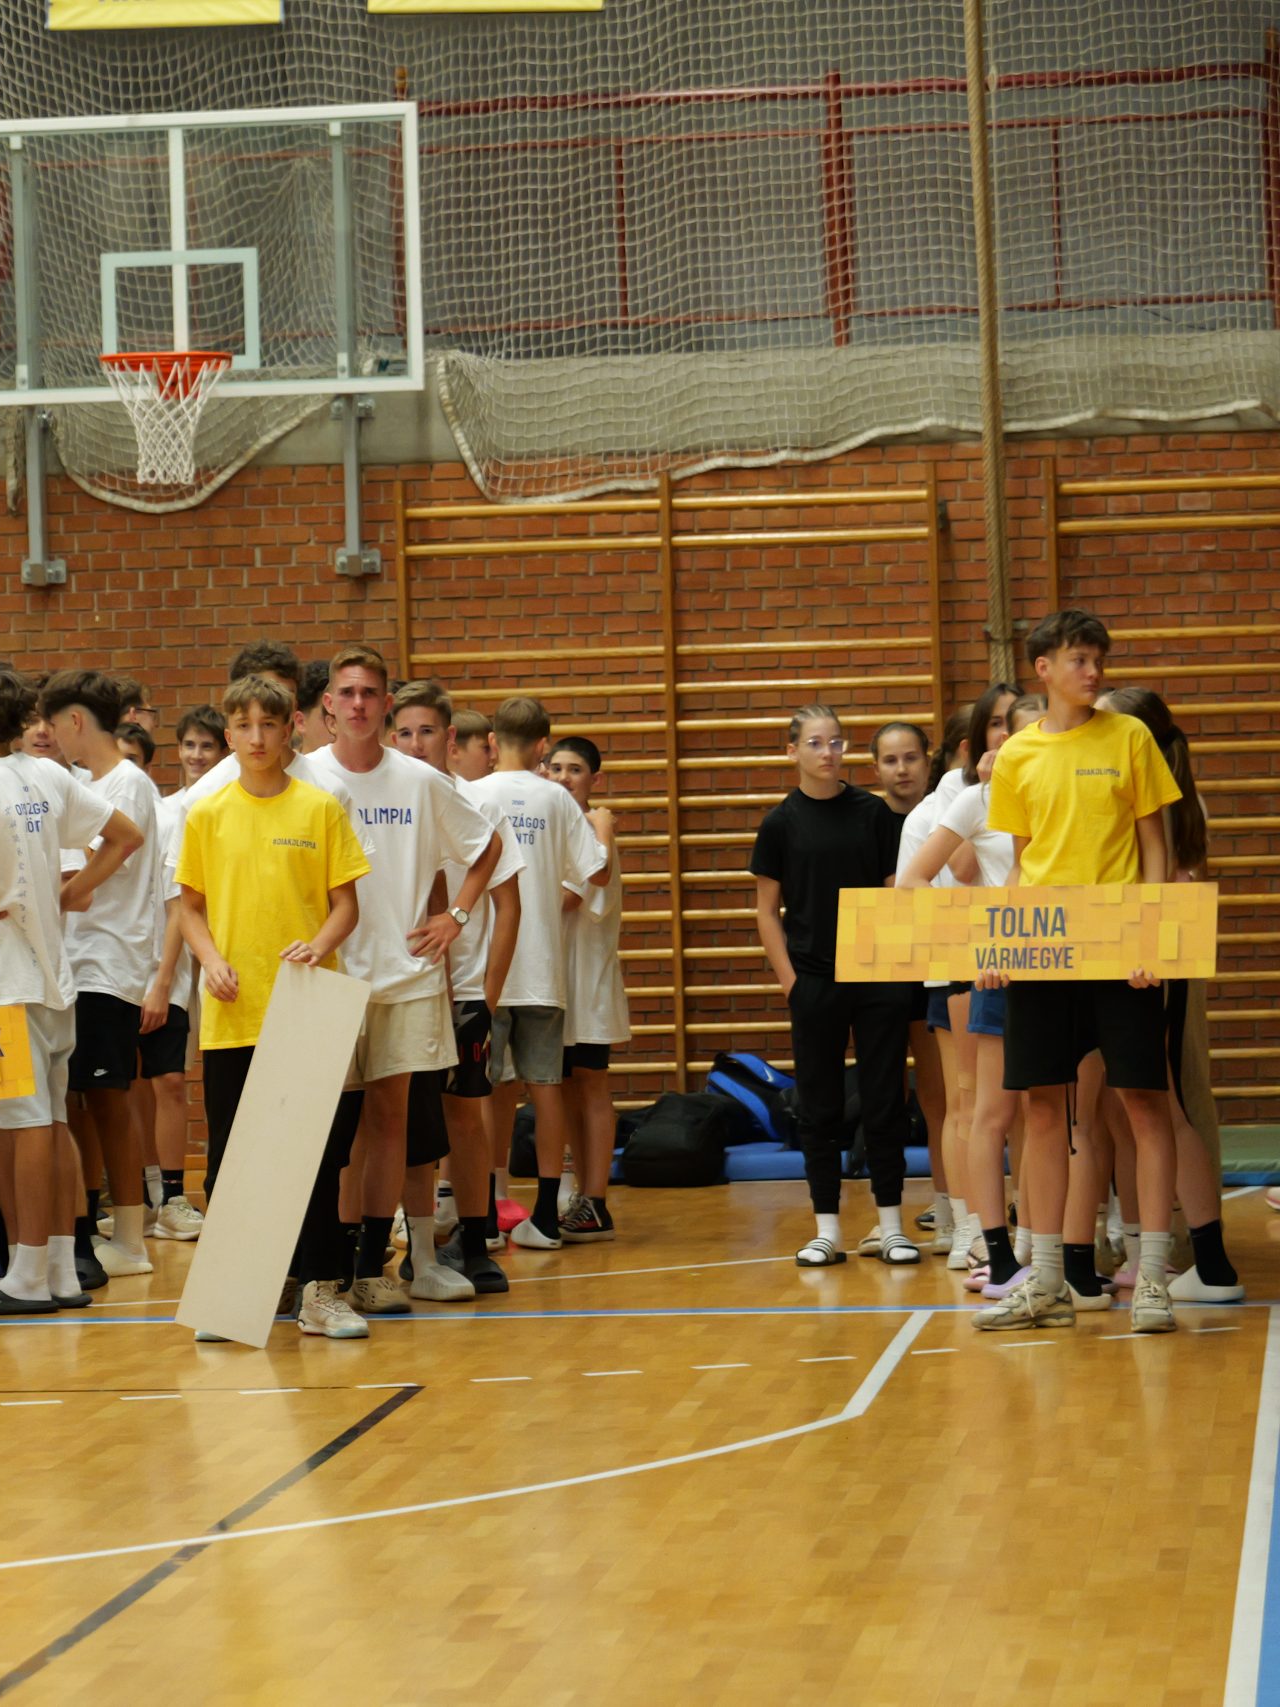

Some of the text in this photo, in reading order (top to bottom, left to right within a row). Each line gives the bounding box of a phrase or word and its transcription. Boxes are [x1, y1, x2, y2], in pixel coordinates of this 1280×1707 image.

[508, 813, 546, 830] ZÁGOS
[985, 906, 1066, 938] TOLNA
[975, 943, 1075, 970] VÁRMEGYE
